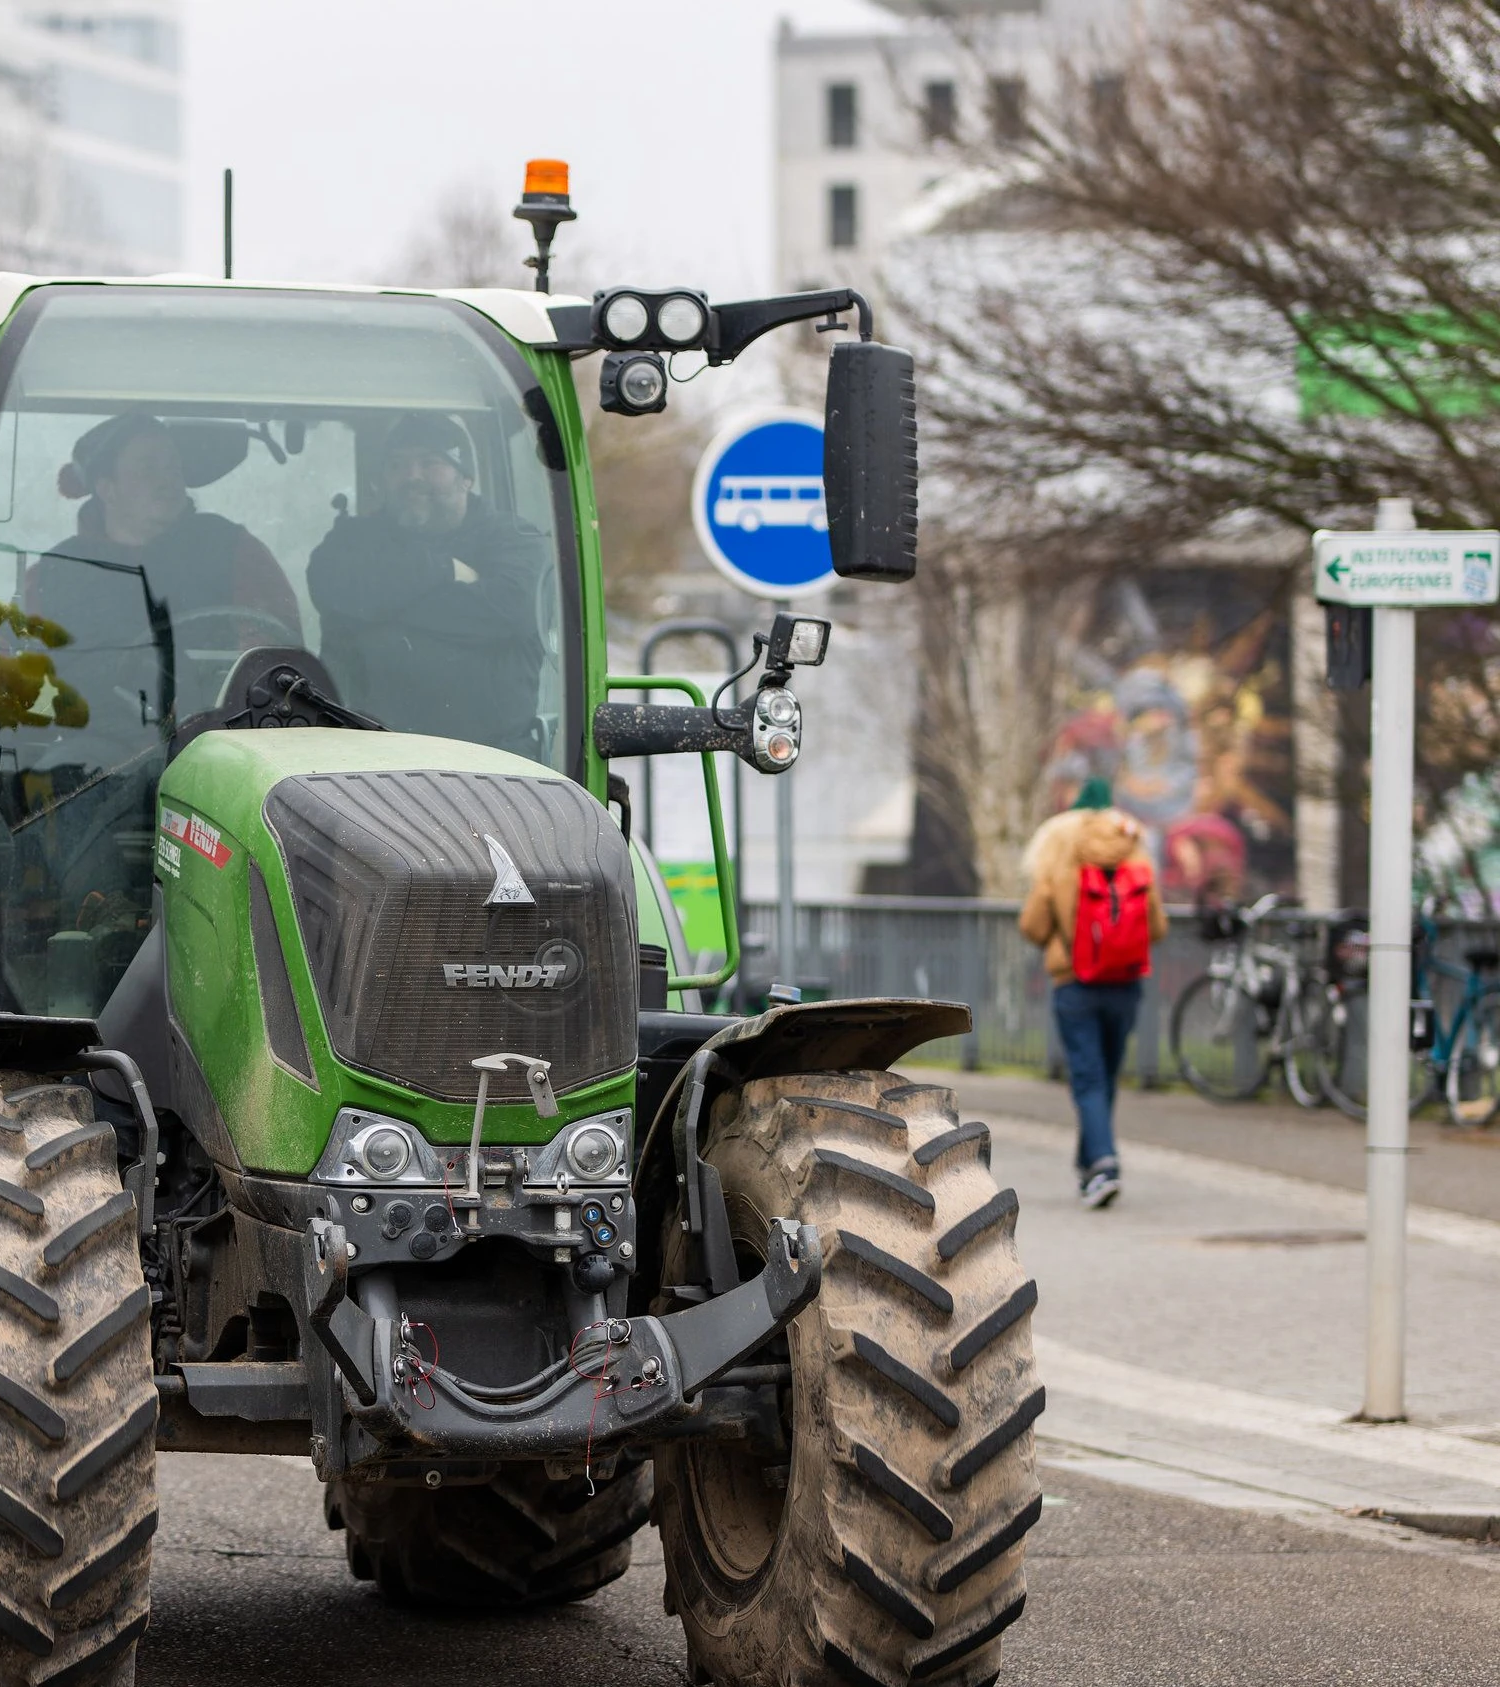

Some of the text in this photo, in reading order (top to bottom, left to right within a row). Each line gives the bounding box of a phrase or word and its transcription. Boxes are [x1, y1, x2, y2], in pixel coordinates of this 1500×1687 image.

[1352, 548, 1450, 563] INSTITUTIONS
[189, 813, 221, 858] FENDT
[443, 964, 566, 987] FENDT
